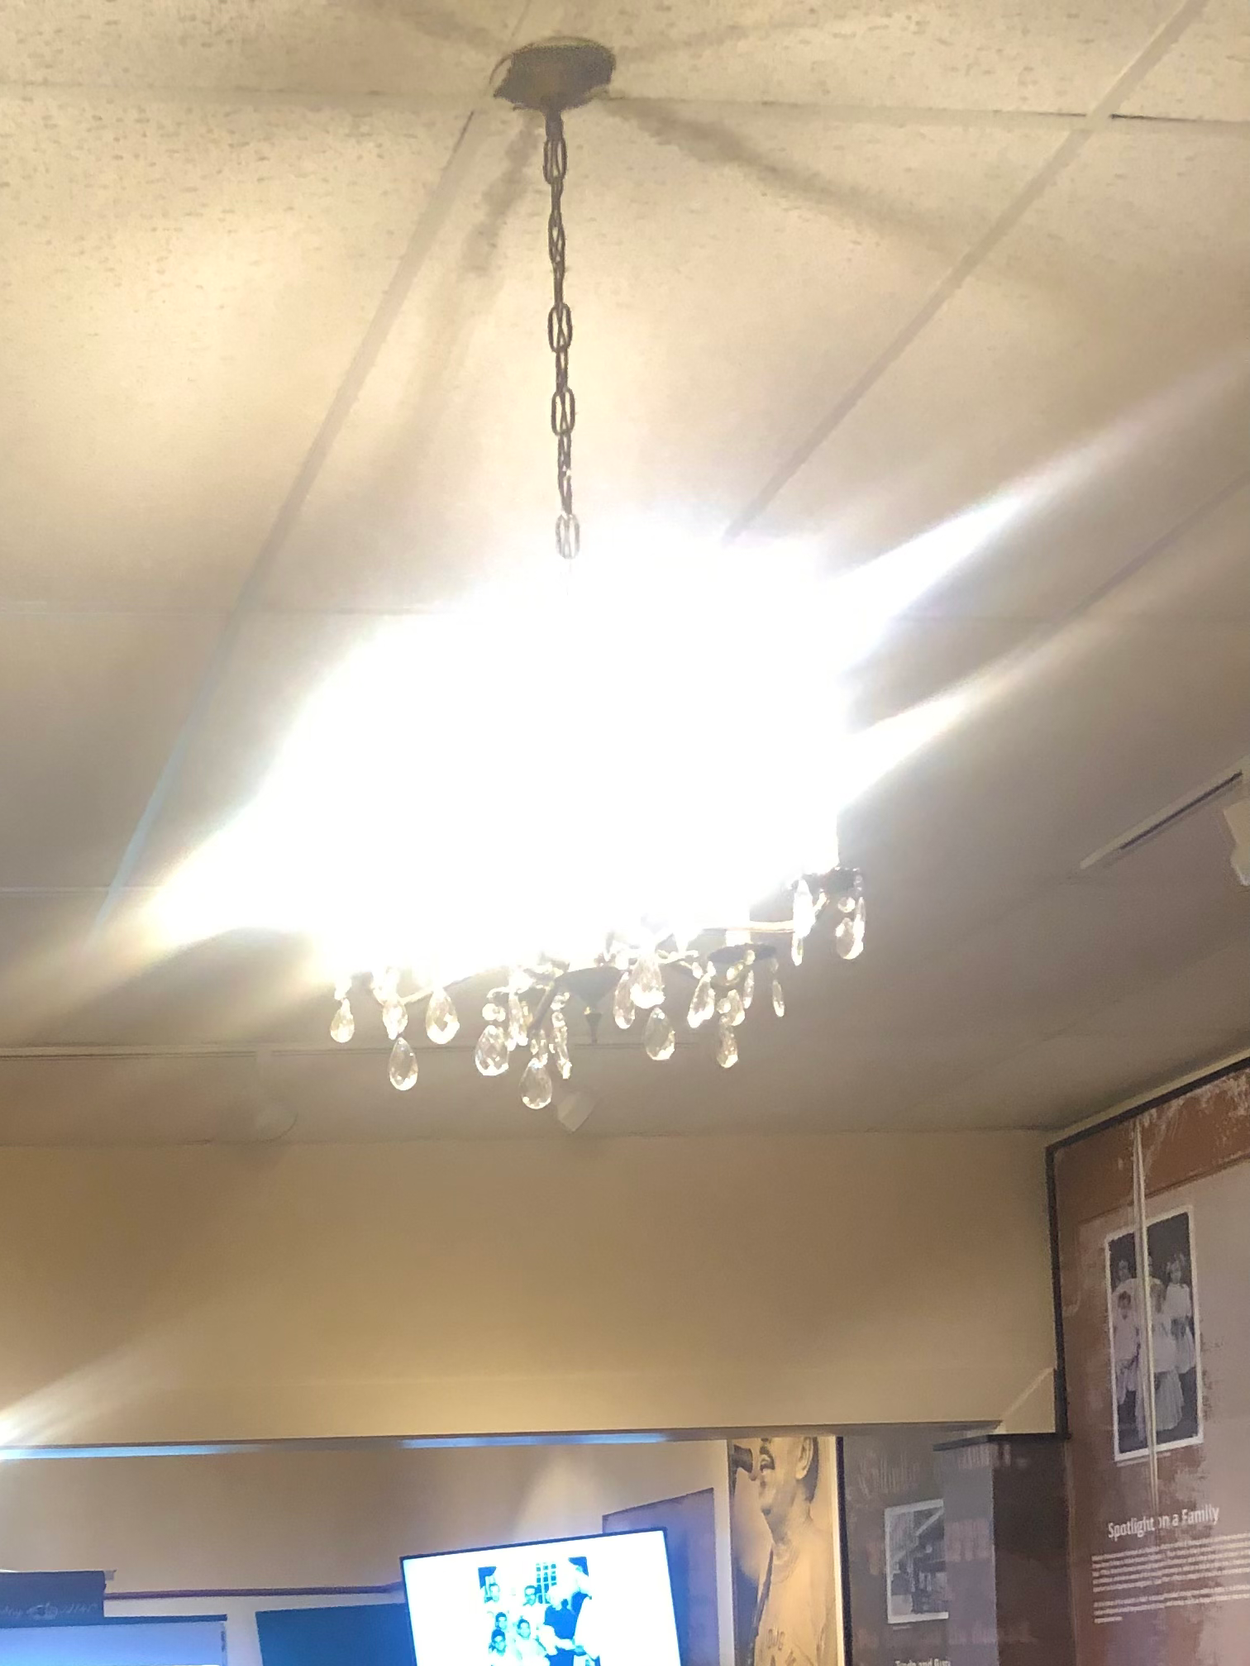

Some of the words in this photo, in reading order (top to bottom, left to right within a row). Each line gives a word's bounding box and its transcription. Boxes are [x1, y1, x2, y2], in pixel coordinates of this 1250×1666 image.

[1108, 1515, 1155, 1541] Spotlight
[1172, 1513, 1180, 1527] a
[1181, 1504, 1220, 1525] Family
